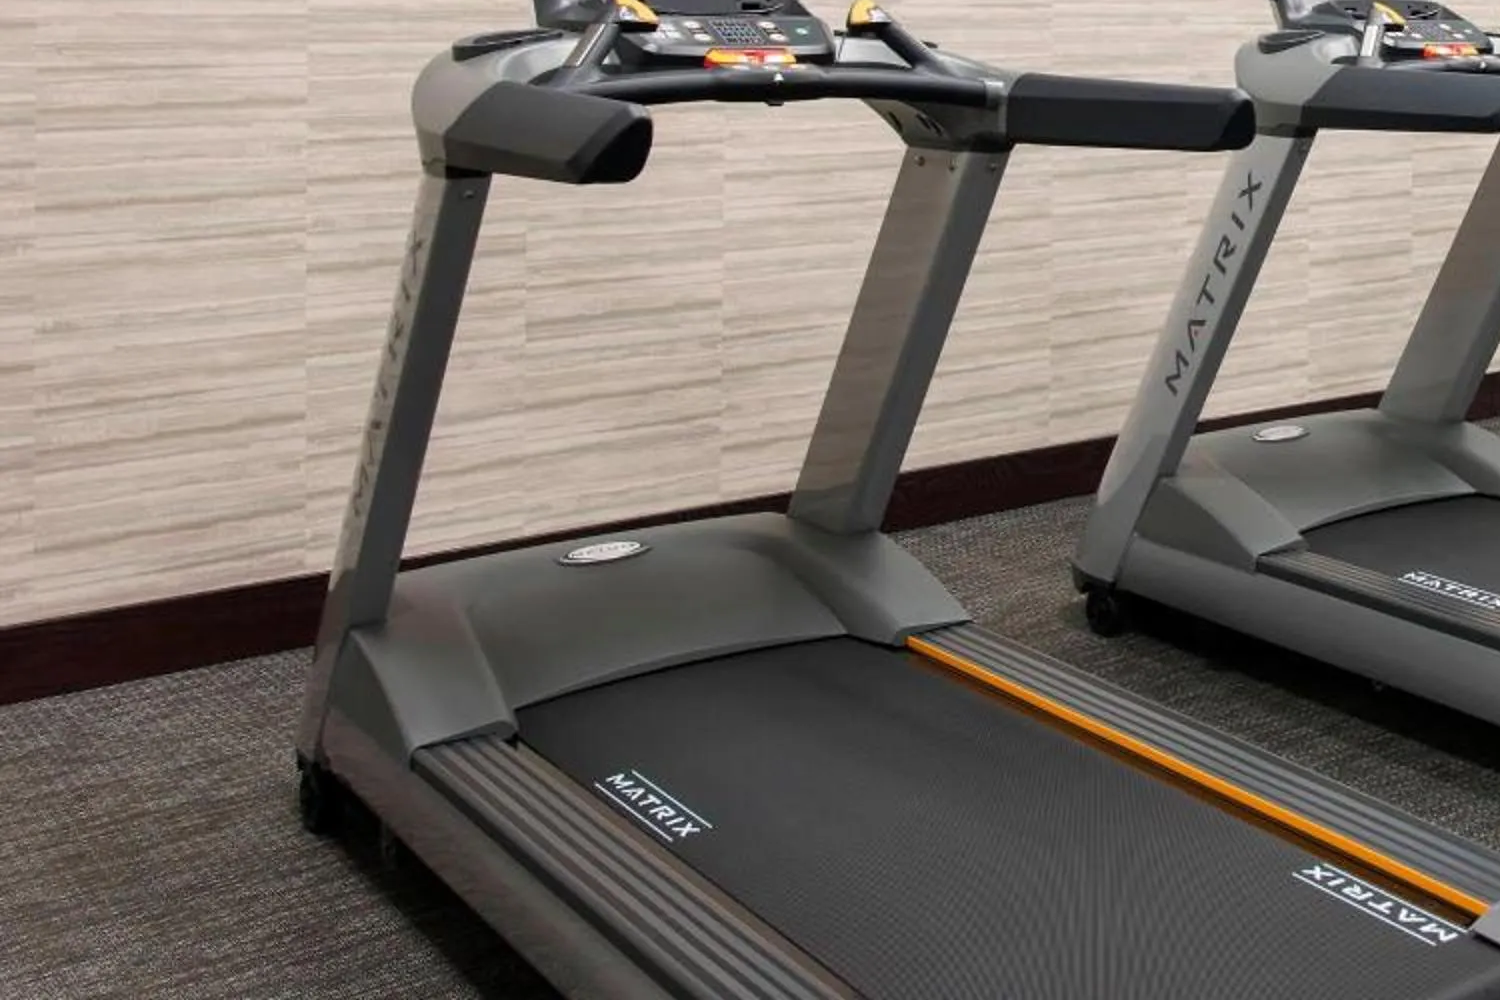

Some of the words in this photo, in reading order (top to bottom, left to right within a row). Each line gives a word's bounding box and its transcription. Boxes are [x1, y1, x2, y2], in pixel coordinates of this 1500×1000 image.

[1164, 169, 1263, 398] MATRIX
[605, 773, 701, 838] MATRIX
[1301, 865, 1460, 943] MATRIX
